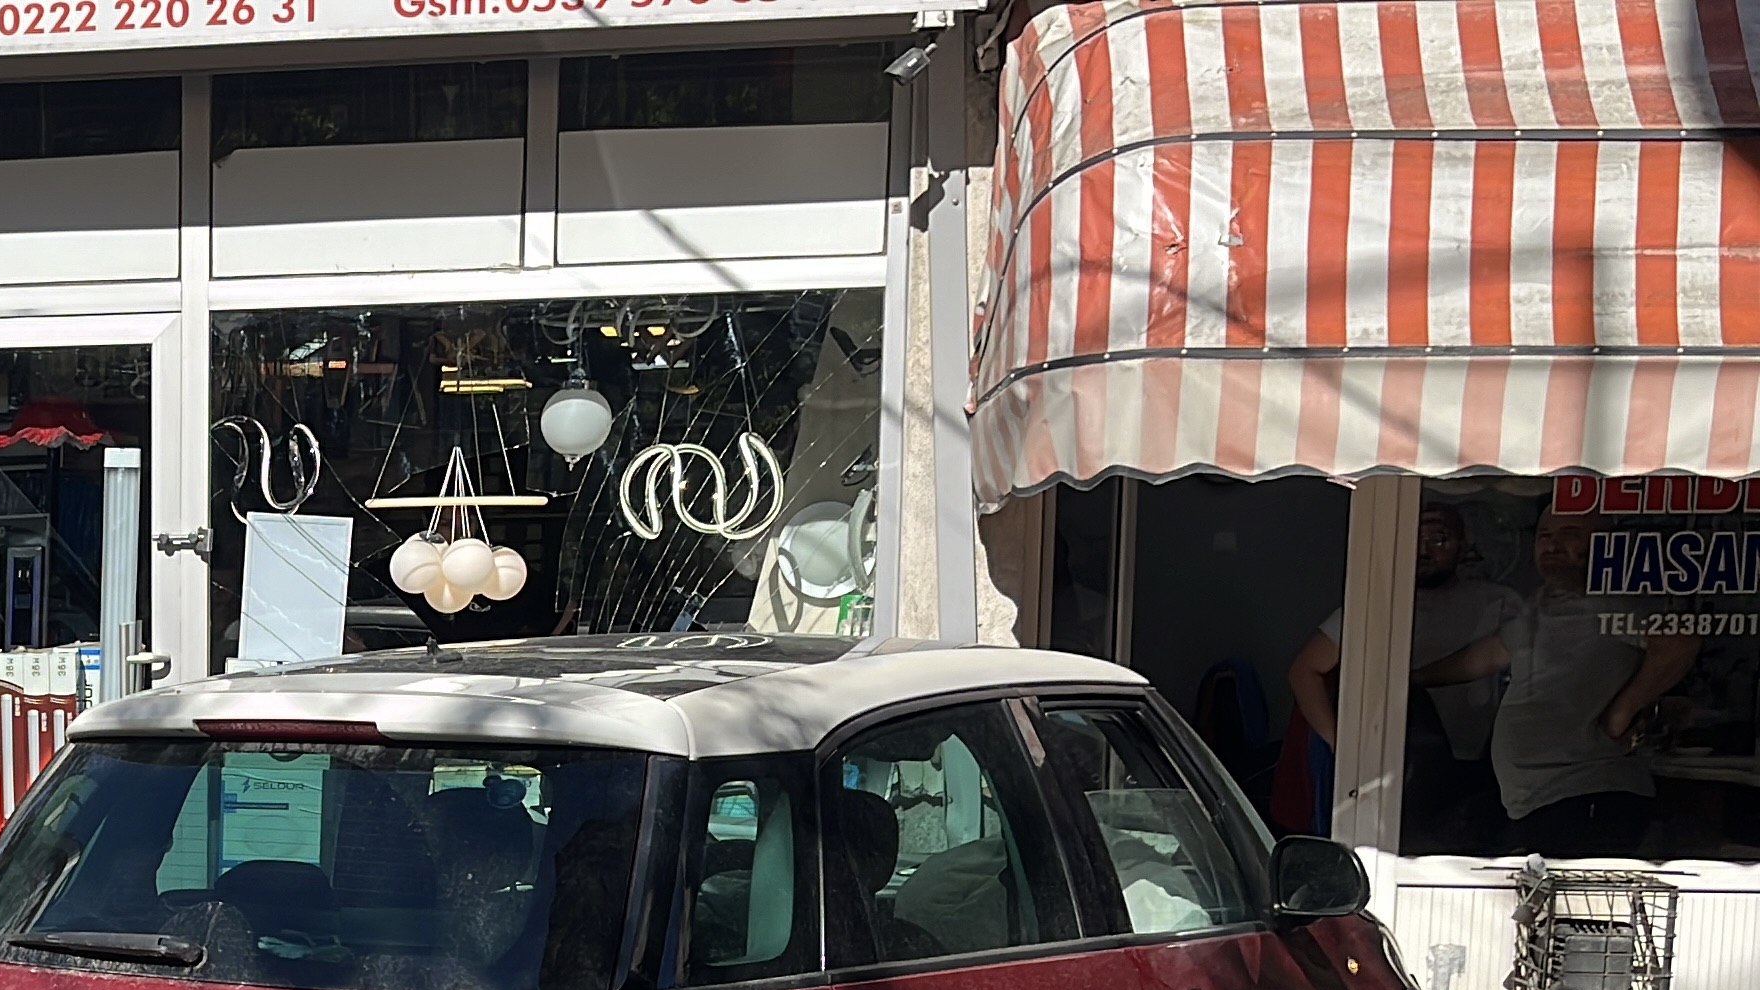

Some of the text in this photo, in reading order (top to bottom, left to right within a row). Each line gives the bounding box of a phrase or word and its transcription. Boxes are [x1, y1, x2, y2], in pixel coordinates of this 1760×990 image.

[114, 0, 190, 30] 220
[206, 0, 256, 26] 26
[272, 0, 317, 24] 31
